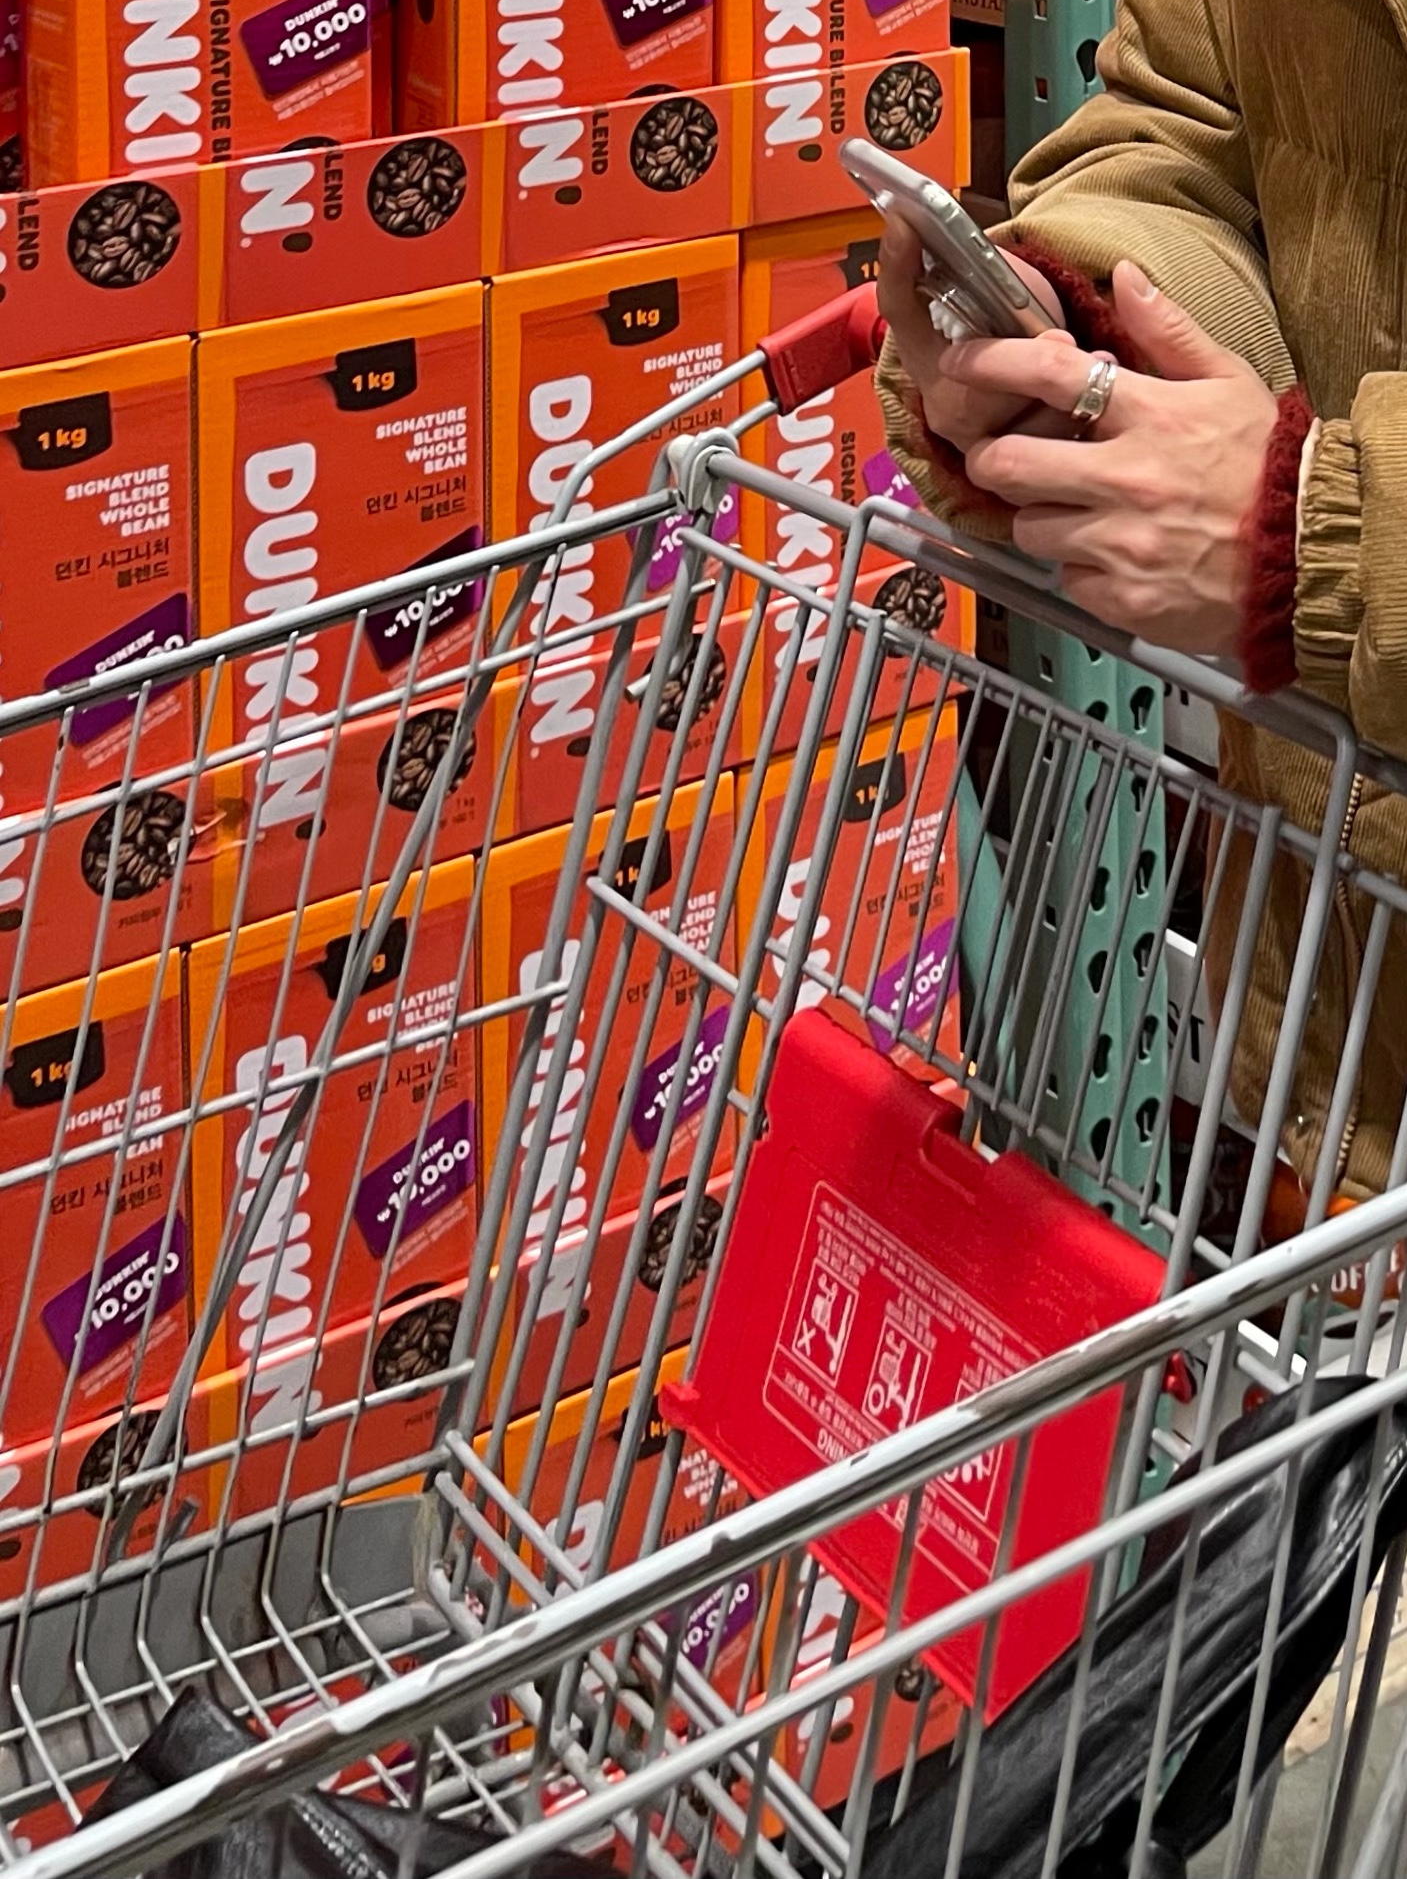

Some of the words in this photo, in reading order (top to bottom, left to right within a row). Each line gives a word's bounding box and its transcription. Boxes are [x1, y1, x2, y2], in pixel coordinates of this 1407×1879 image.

[622, 312, 632, 328] 1
[636, 308, 660, 327] kg
[643, 342, 723, 373] SIGNATURE
[352, 374, 363, 393] 1
[368, 371, 395, 391] kg
[375, 406, 467, 440] SIGNATURE
[413, 422, 467, 447] BLEND
[38, 431, 50, 451] 1
[56, 427, 87, 449] kg
[405, 436, 467, 464] WHOLE
[423, 452, 467, 475] BEAN
[65, 464, 170, 502] SIGNATURE
[109, 481, 170, 508] BLEND
[99, 497, 170, 526] WHOLE
[120, 512, 170, 537] BEAN
